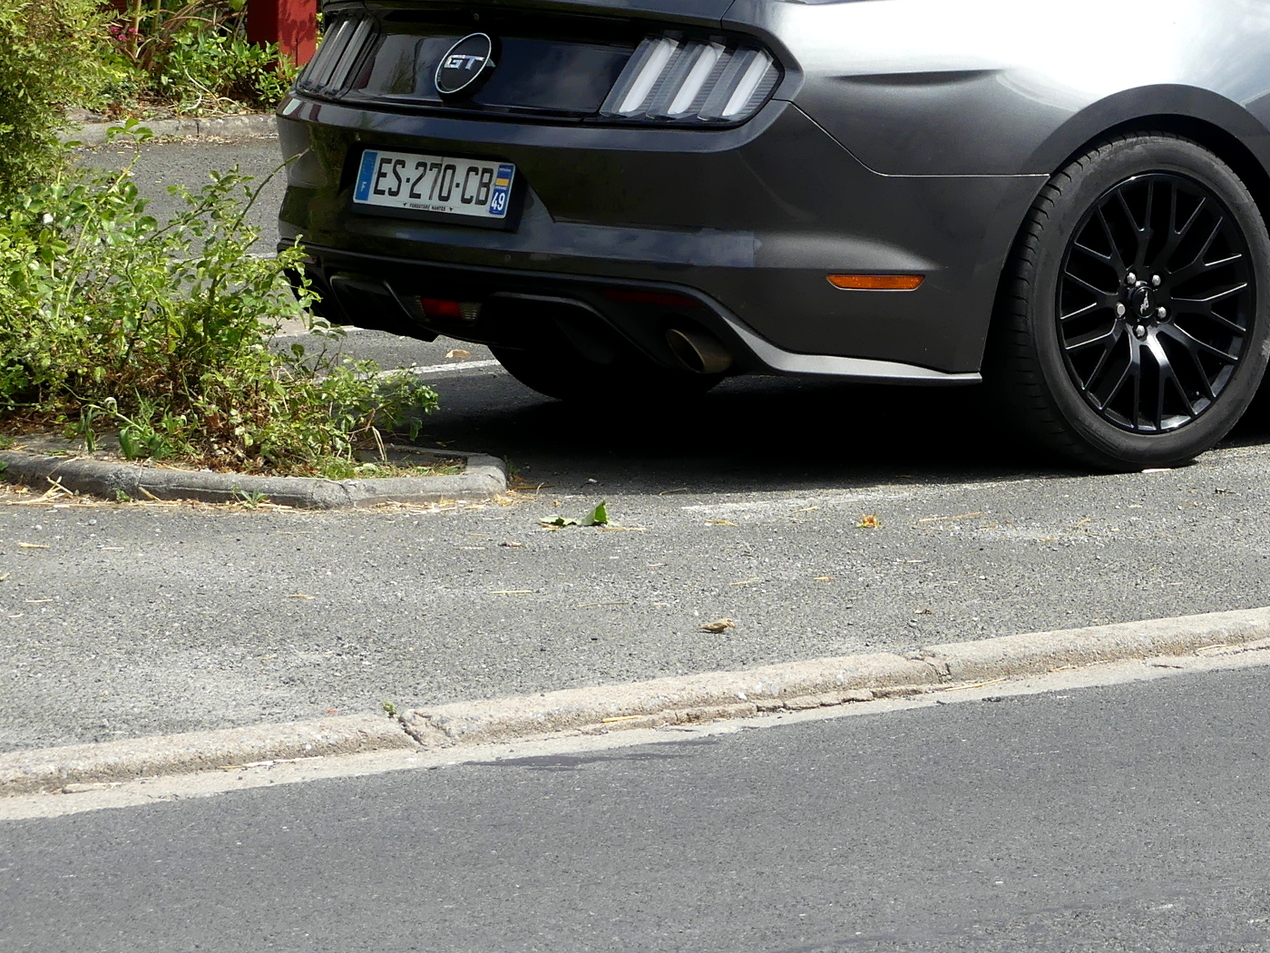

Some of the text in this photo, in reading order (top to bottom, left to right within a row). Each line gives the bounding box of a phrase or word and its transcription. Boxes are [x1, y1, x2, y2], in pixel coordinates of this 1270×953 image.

[444, 54, 485, 70] GT
[360, 181, 368, 192] F
[373, 157, 494, 206] ES-270-CB
[491, 191, 506, 211] 49
